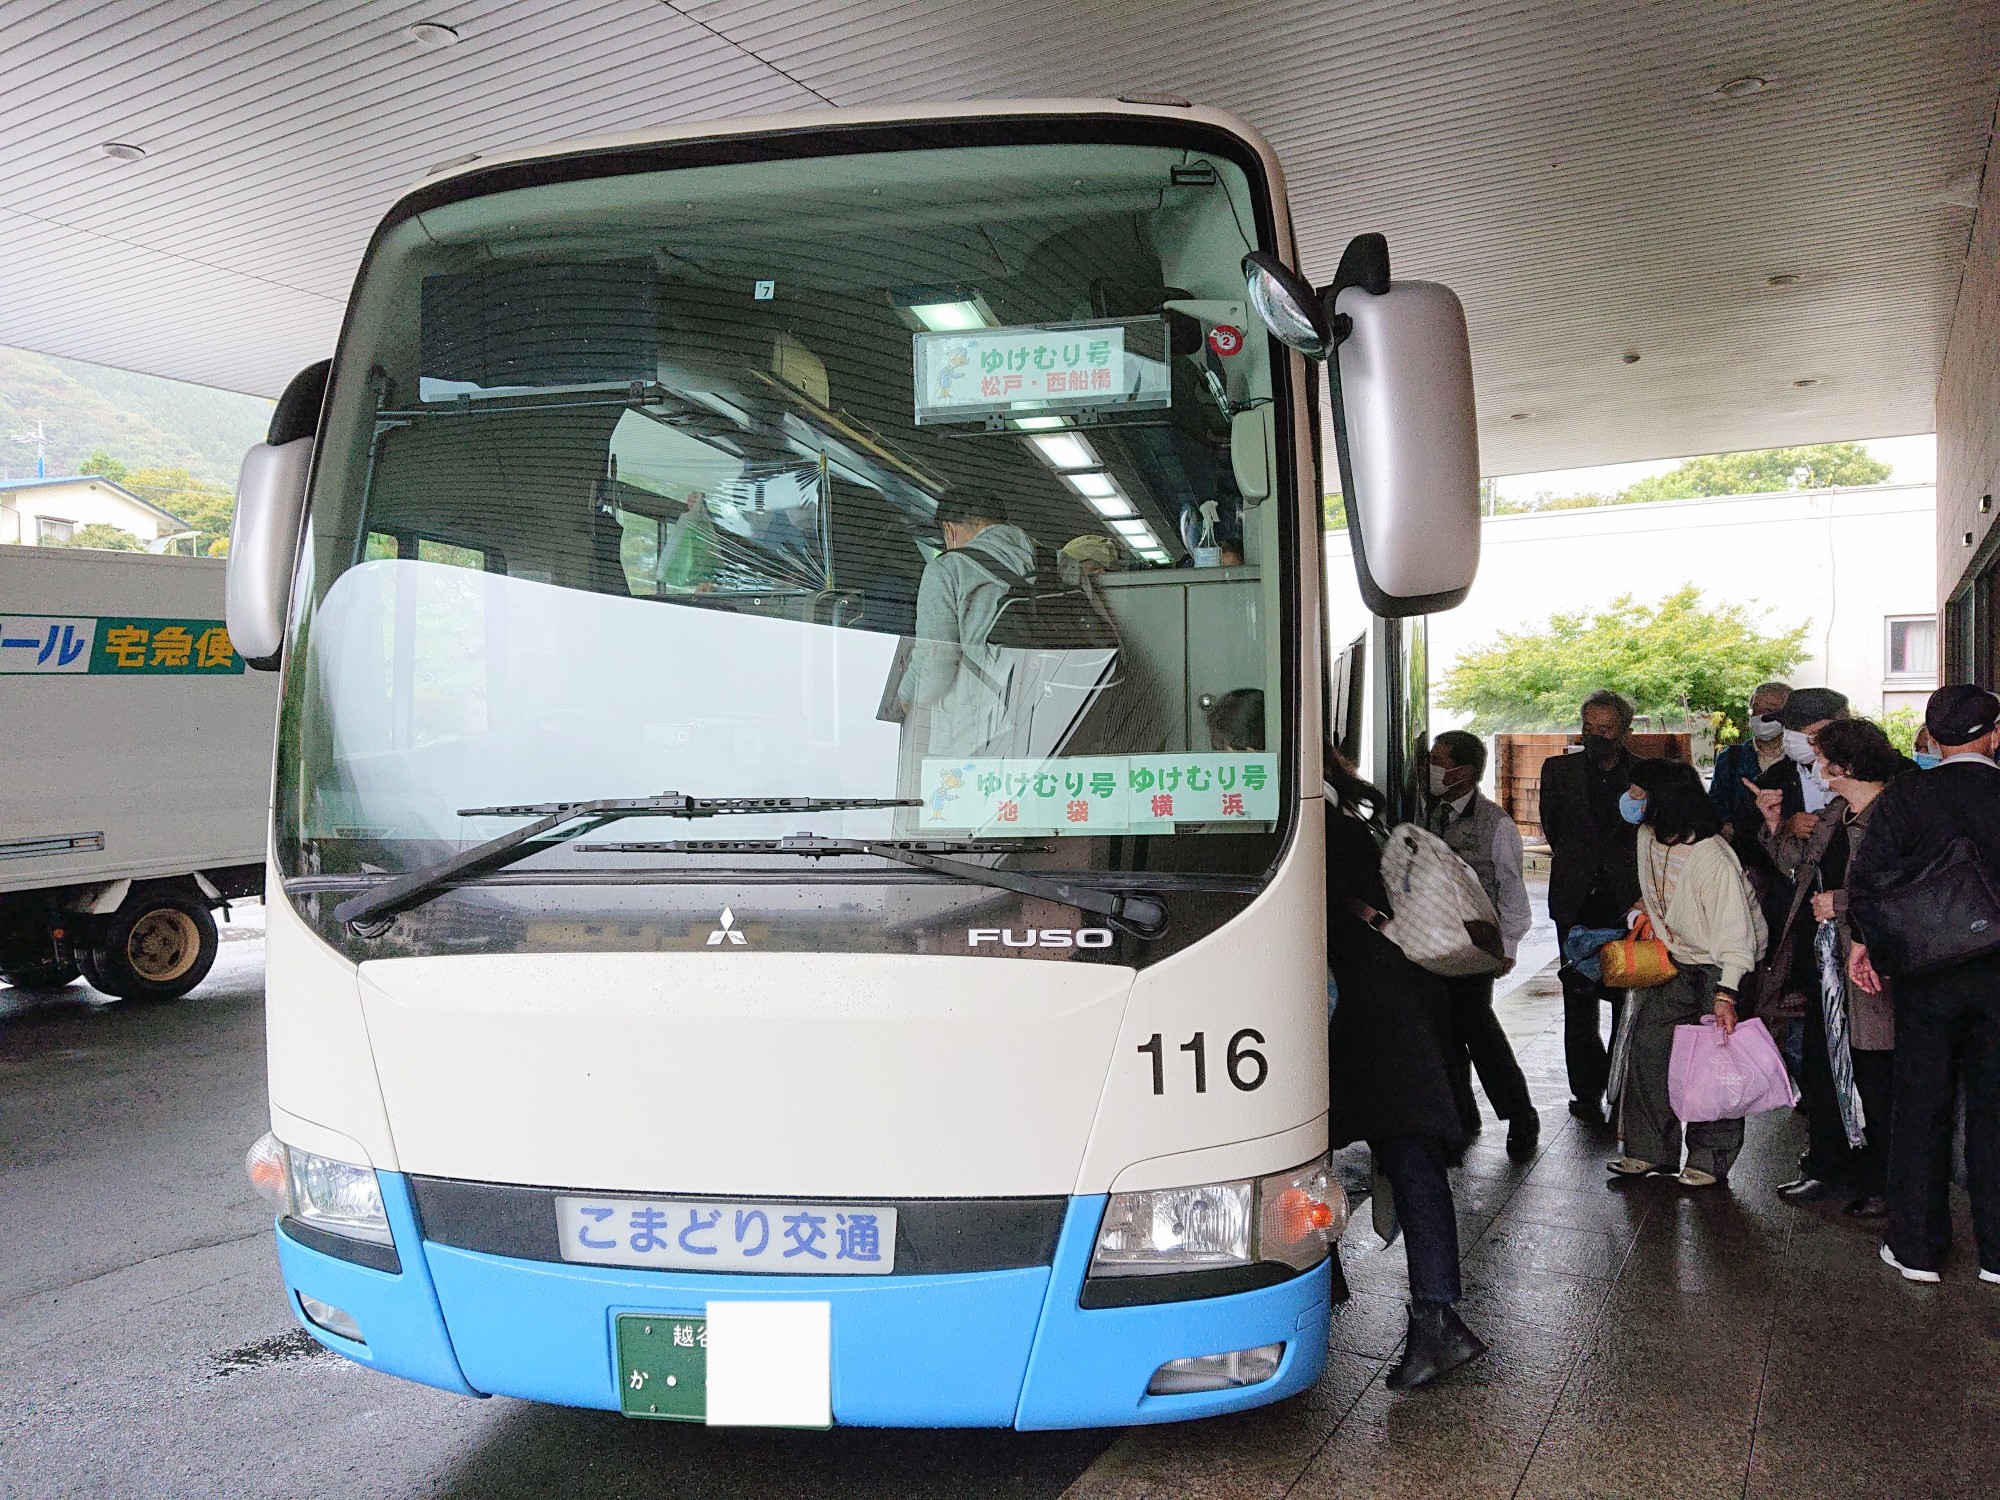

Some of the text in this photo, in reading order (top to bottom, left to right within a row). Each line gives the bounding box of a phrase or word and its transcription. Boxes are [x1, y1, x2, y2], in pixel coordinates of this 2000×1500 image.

[763, 286, 770, 298] 7
[1222, 336, 1231, 346] 2
[980, 340, 1112, 374] ゆけむり号
[980, 368, 1112, 397] 松戸・西船橋
[0, 624, 237, 668] ール 宅急便
[977, 771, 1117, 799] ゆけむり号
[1129, 764, 1268, 793] ゆけむり号
[968, 928, 1114, 949] FUSO
[1137, 1027, 1269, 1095] 116
[578, 1206, 882, 1262] こまどり交通
